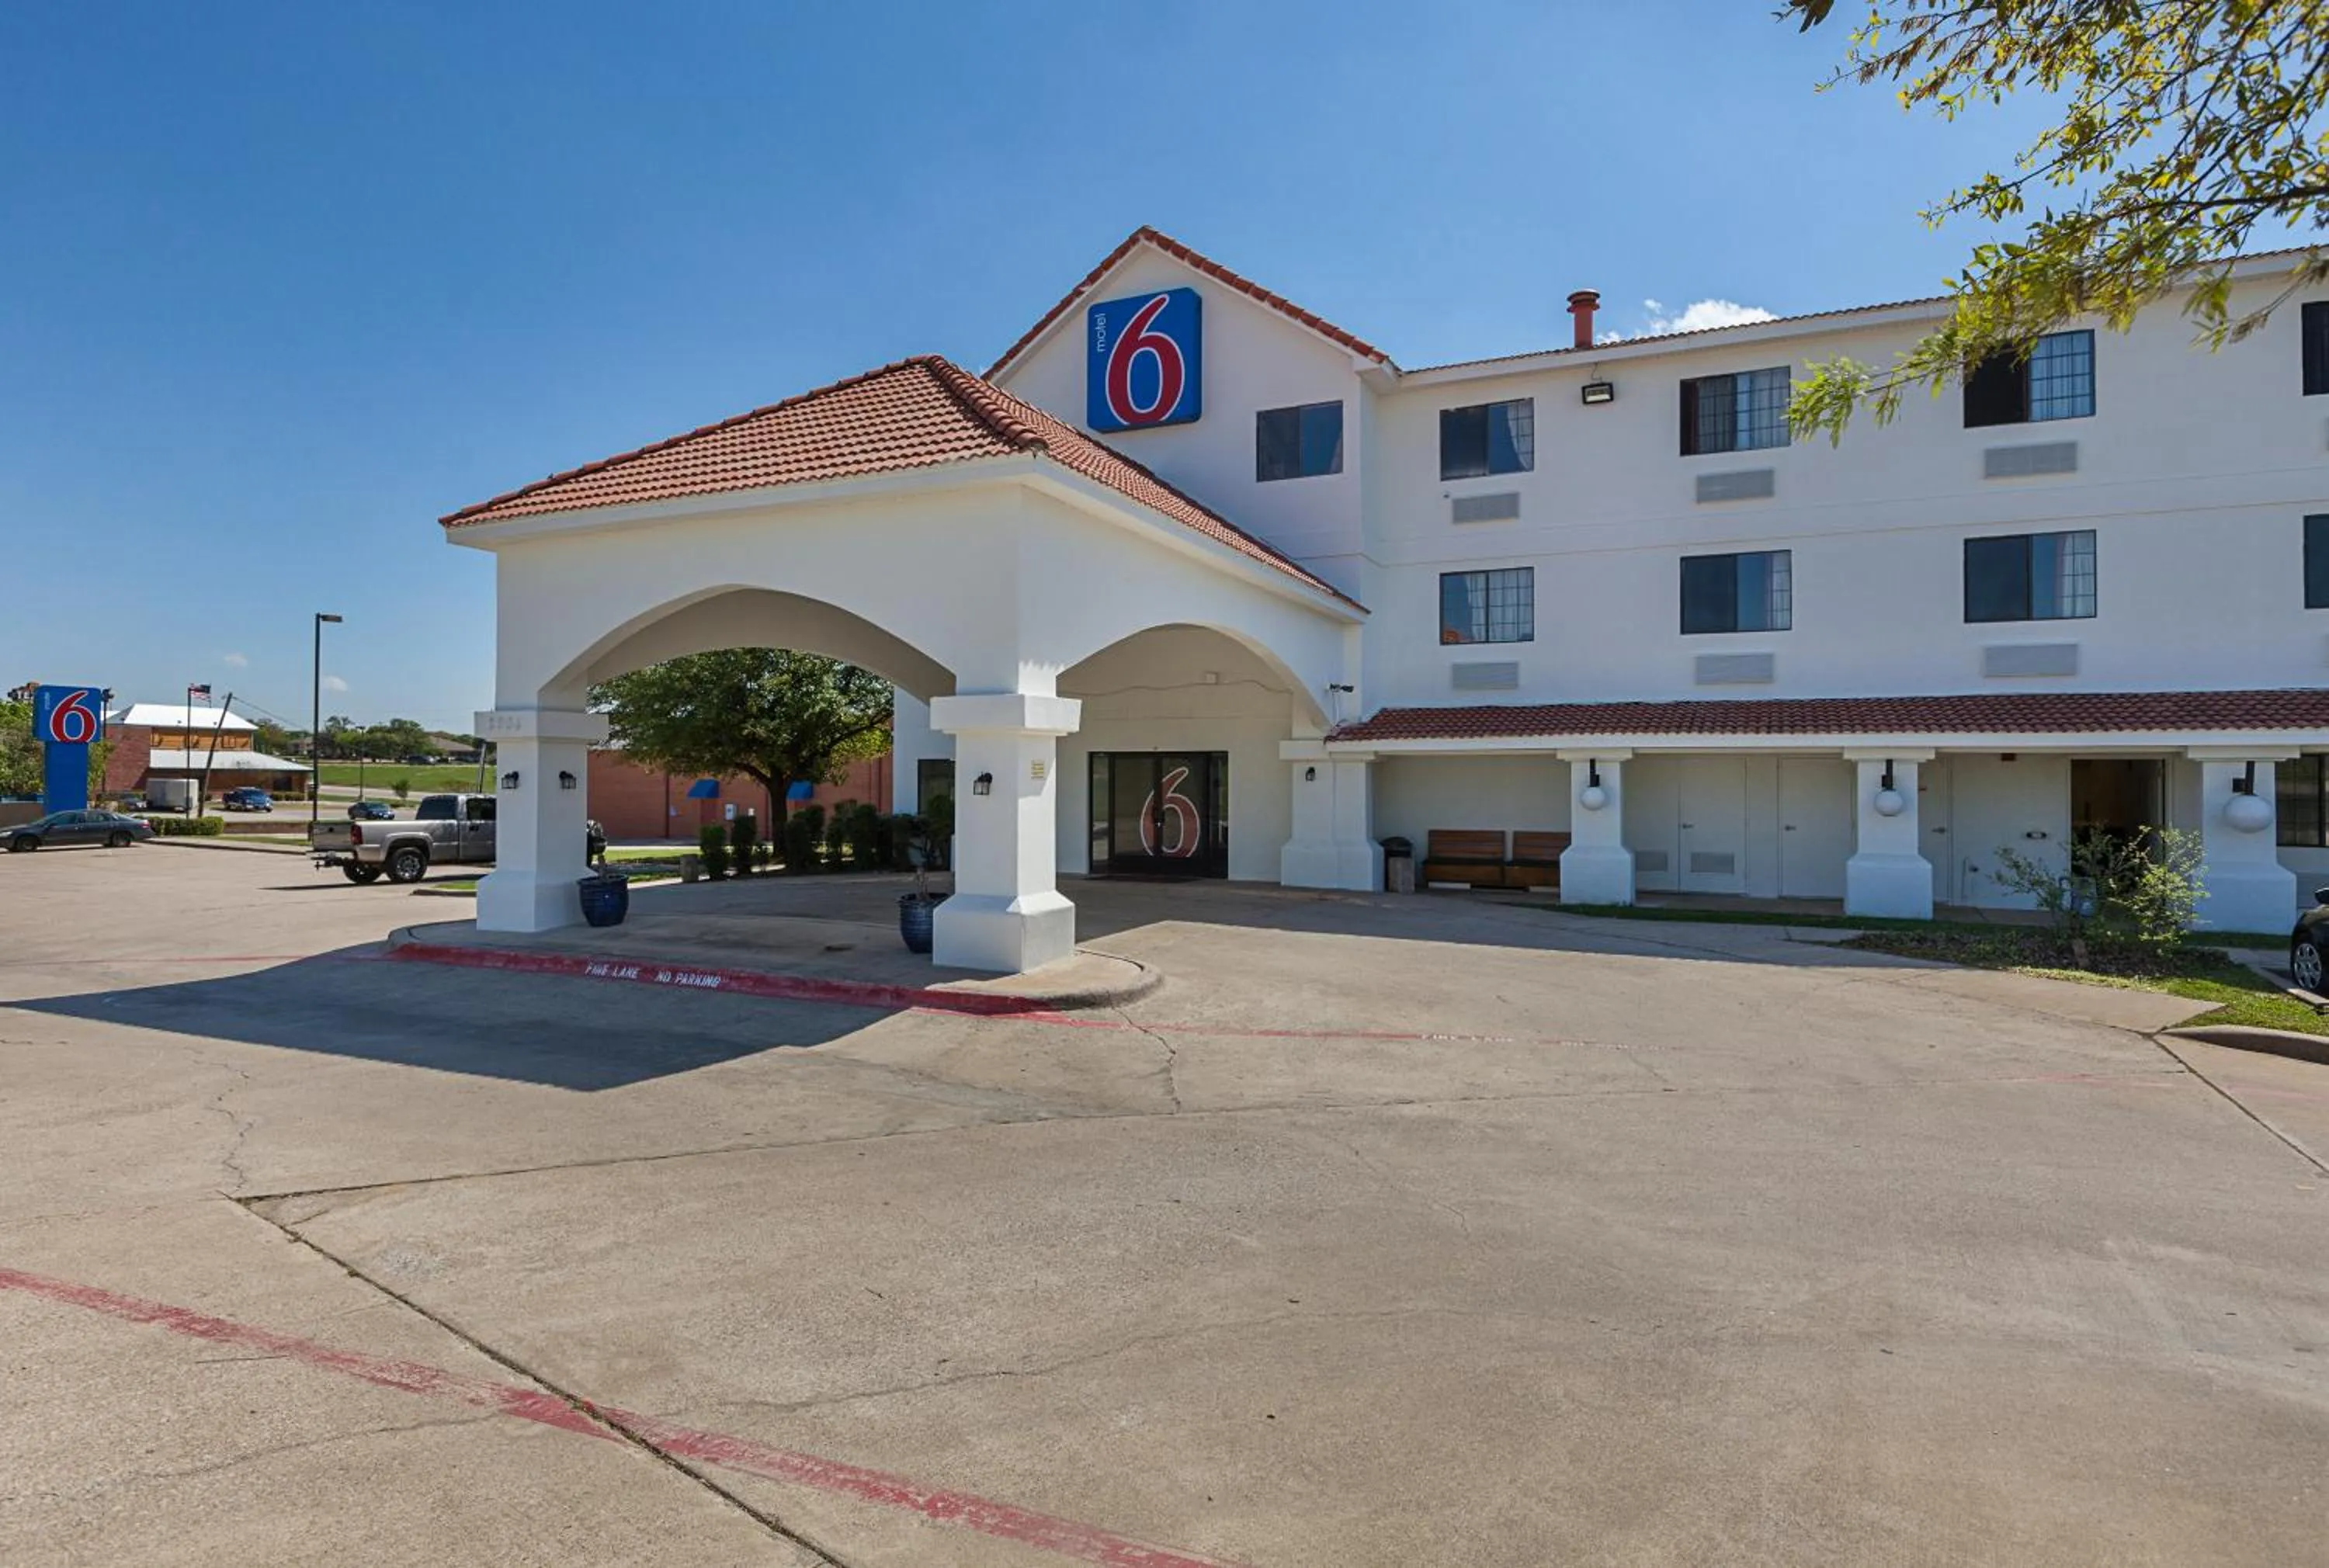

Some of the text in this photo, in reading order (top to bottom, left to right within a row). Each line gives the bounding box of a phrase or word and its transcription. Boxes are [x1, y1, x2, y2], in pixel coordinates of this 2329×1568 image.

[1095, 293, 1185, 425] motel 6
[50, 690, 96, 743] 6
[1140, 766, 1200, 858] 6
[654, 970, 721, 988] NO PARKING
